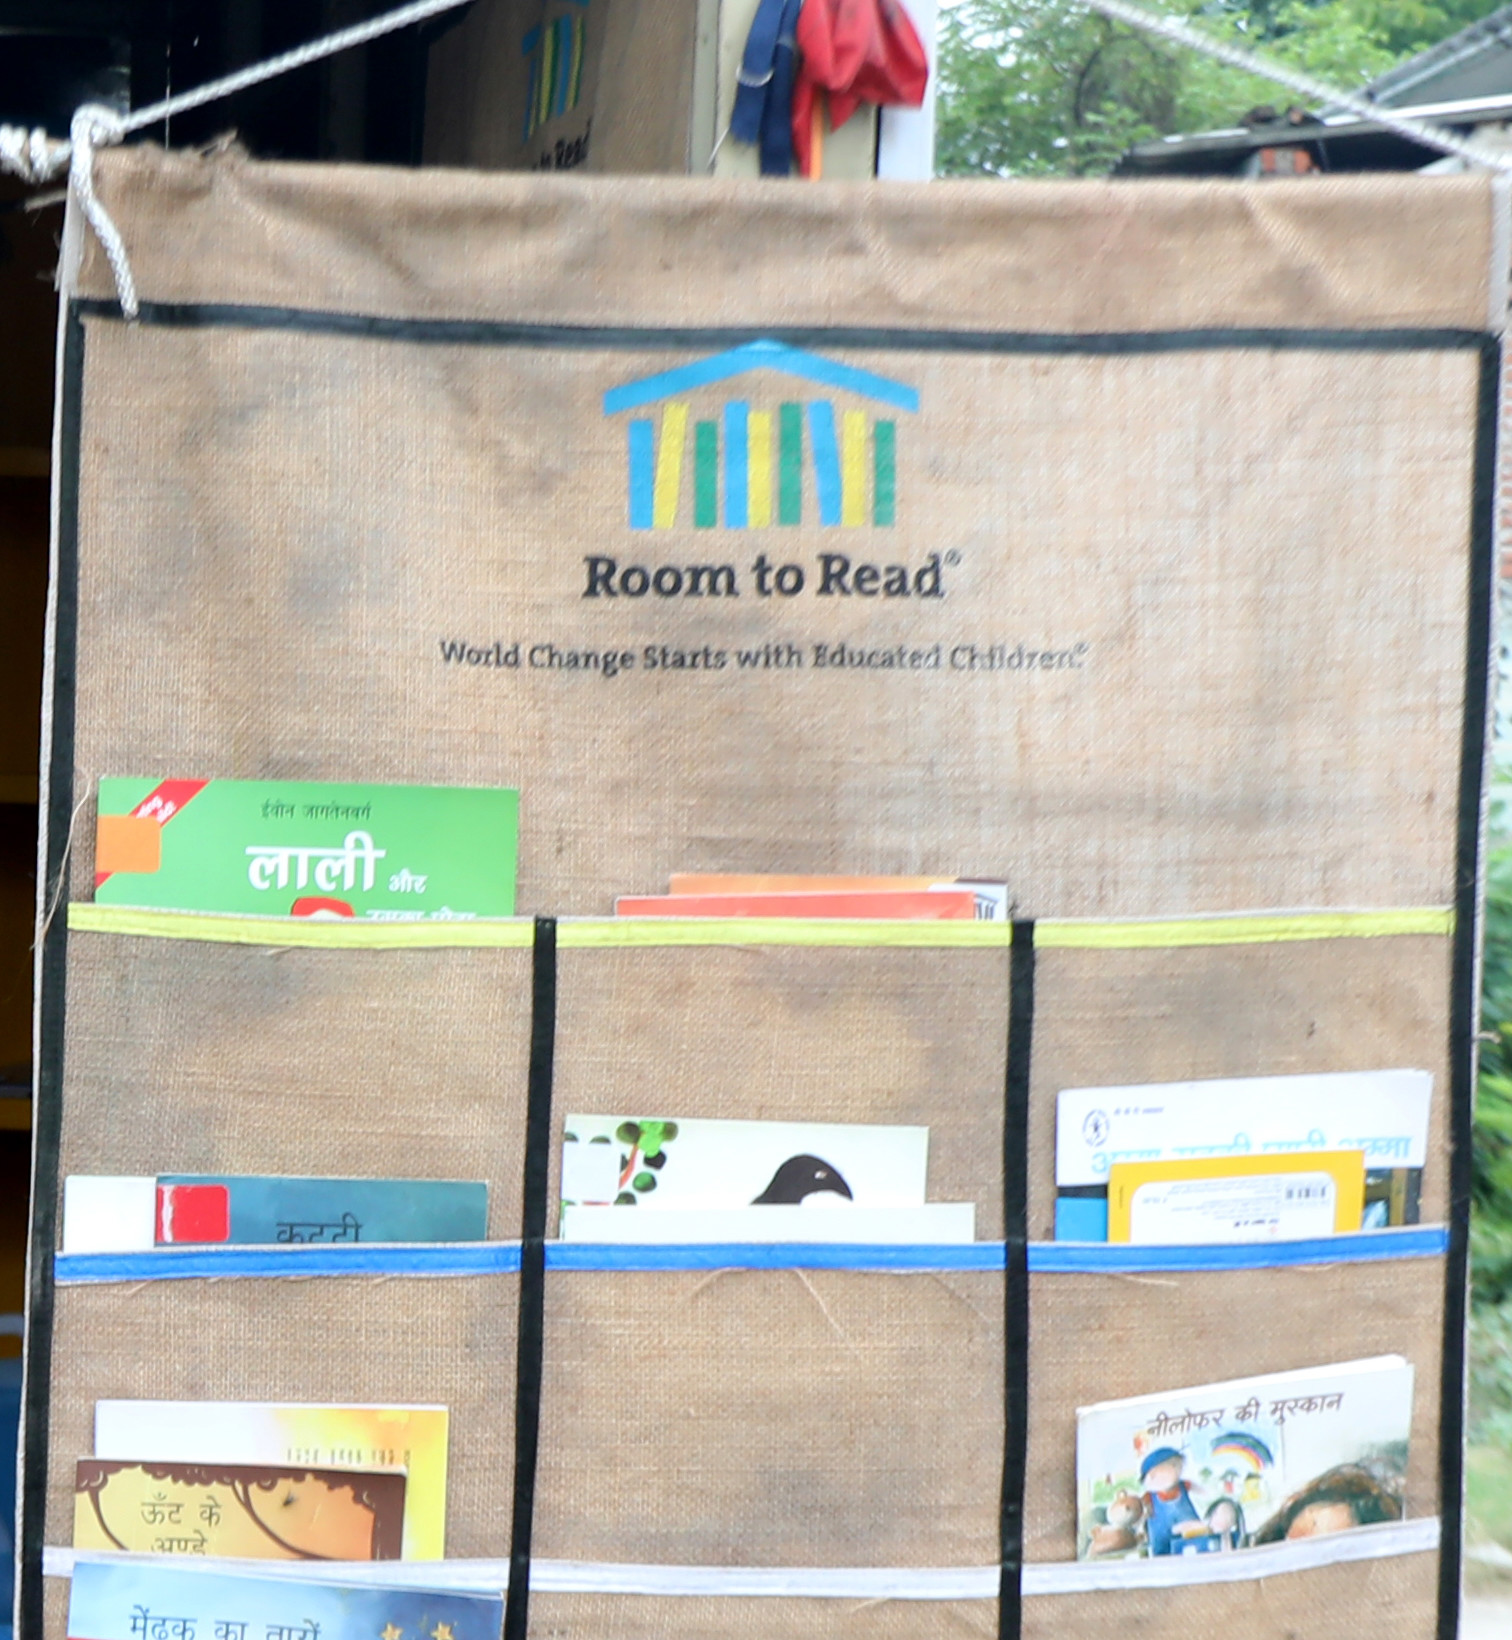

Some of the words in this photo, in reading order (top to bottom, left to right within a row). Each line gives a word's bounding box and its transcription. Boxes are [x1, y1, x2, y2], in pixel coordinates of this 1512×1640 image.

[582, 555, 739, 598] Room
[755, 555, 804, 597] to
[440, 640, 520, 669] World
[529, 643, 634, 676] Change
[643, 643, 727, 670] Starts
[737, 643, 802, 670] with
[812, 643, 941, 670] Educated
[245, 830, 387, 892] लाली
[388, 867, 429, 894] और
[1146, 1407, 1225, 1437] नीलोफर
[1235, 1397, 1260, 1422] की
[1270, 1392, 1345, 1426] मुस्कान
[141, 1492, 185, 1526] ऊँट
[199, 1494, 223, 1528] के
